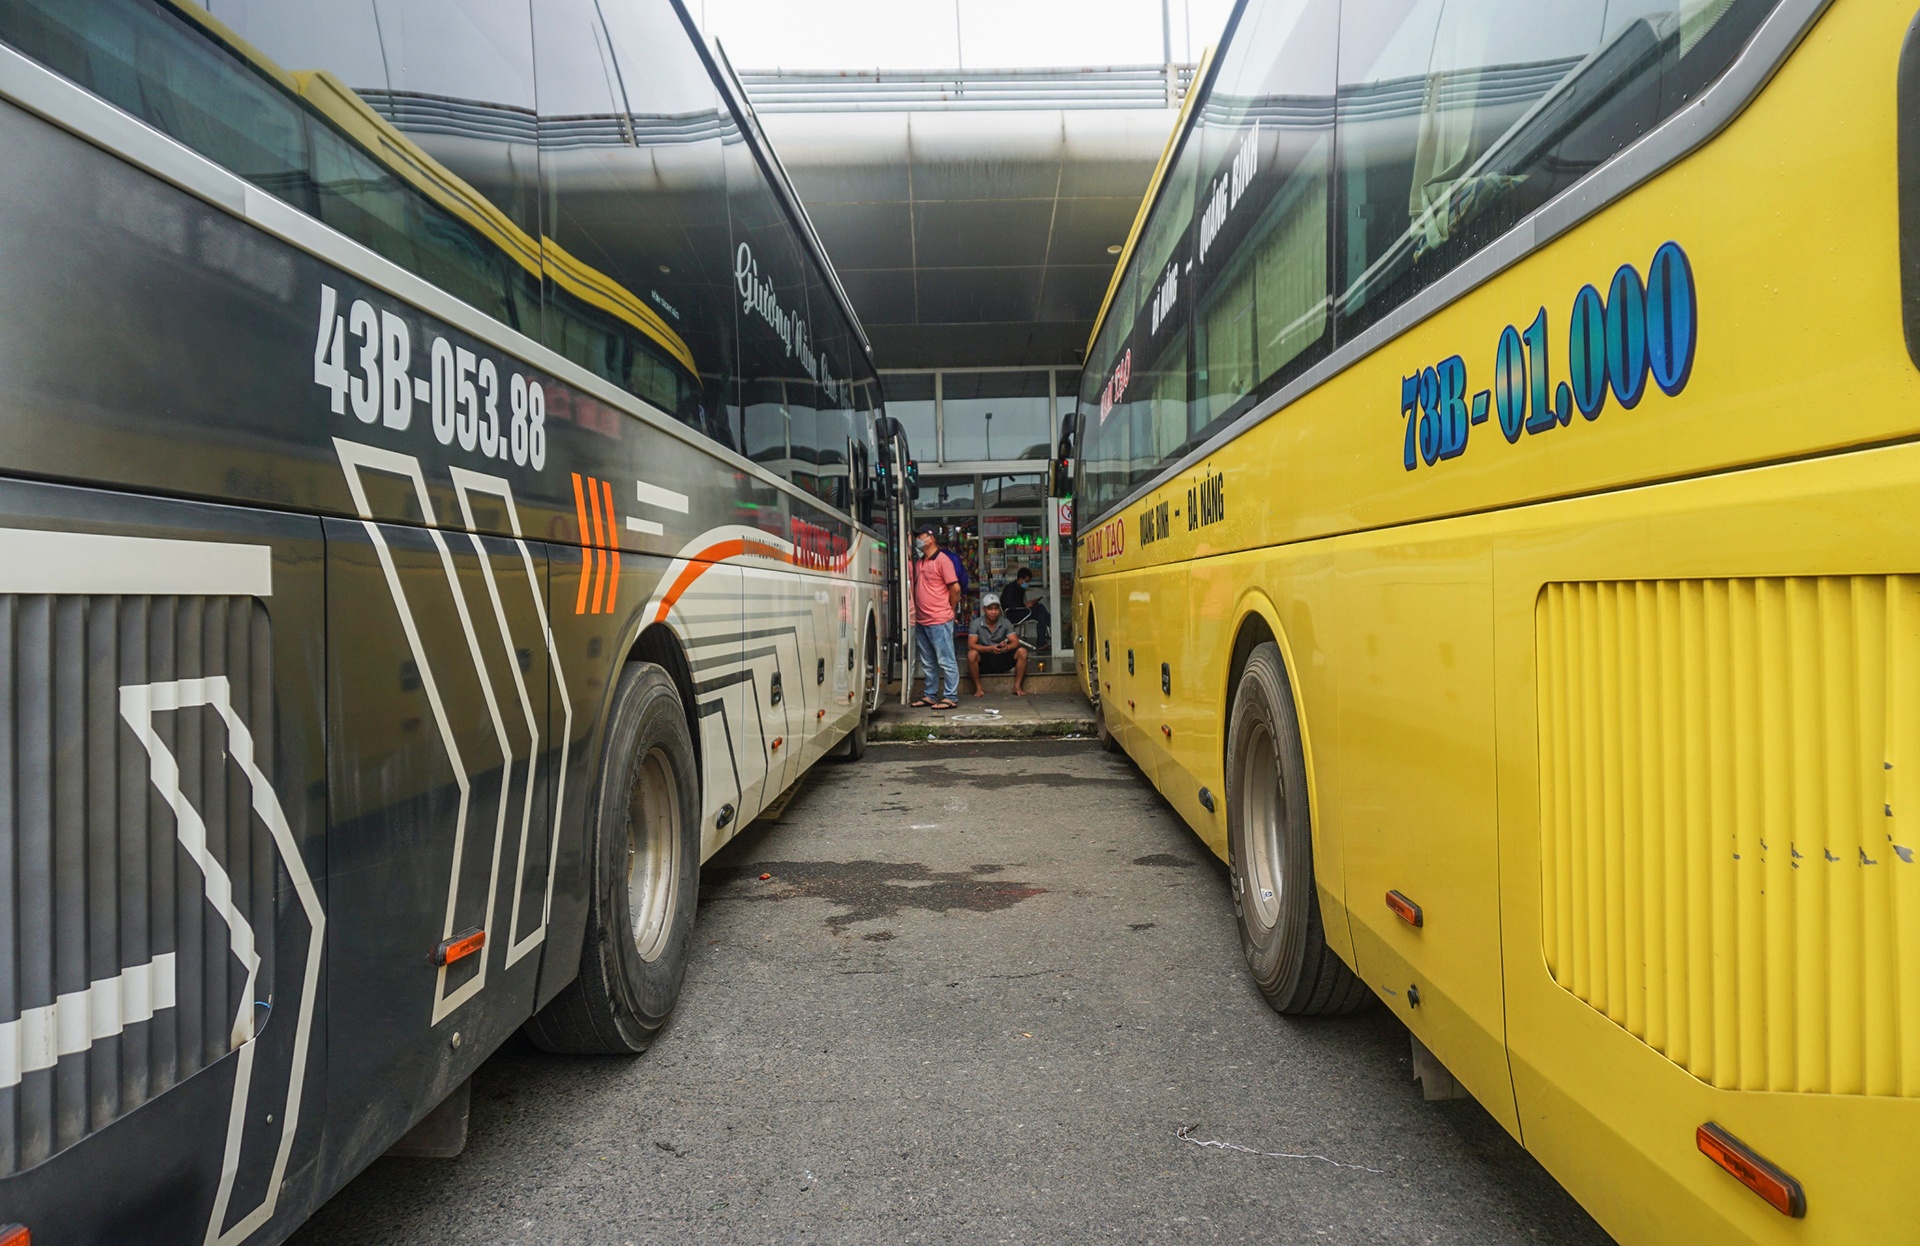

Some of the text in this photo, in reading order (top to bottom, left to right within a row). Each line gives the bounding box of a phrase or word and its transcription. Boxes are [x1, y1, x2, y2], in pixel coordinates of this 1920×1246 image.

[1199, 172, 1228, 264] QUẢNG
[735, 242, 792, 358] Giường
[314, 283, 546, 472] 43B-053.88
[1401, 239, 1698, 472] 73B-01.000
[1086, 528, 1103, 564] NAM
[1105, 516, 1125, 565] TẠO
[1187, 476, 1198, 532] ĐÀ
